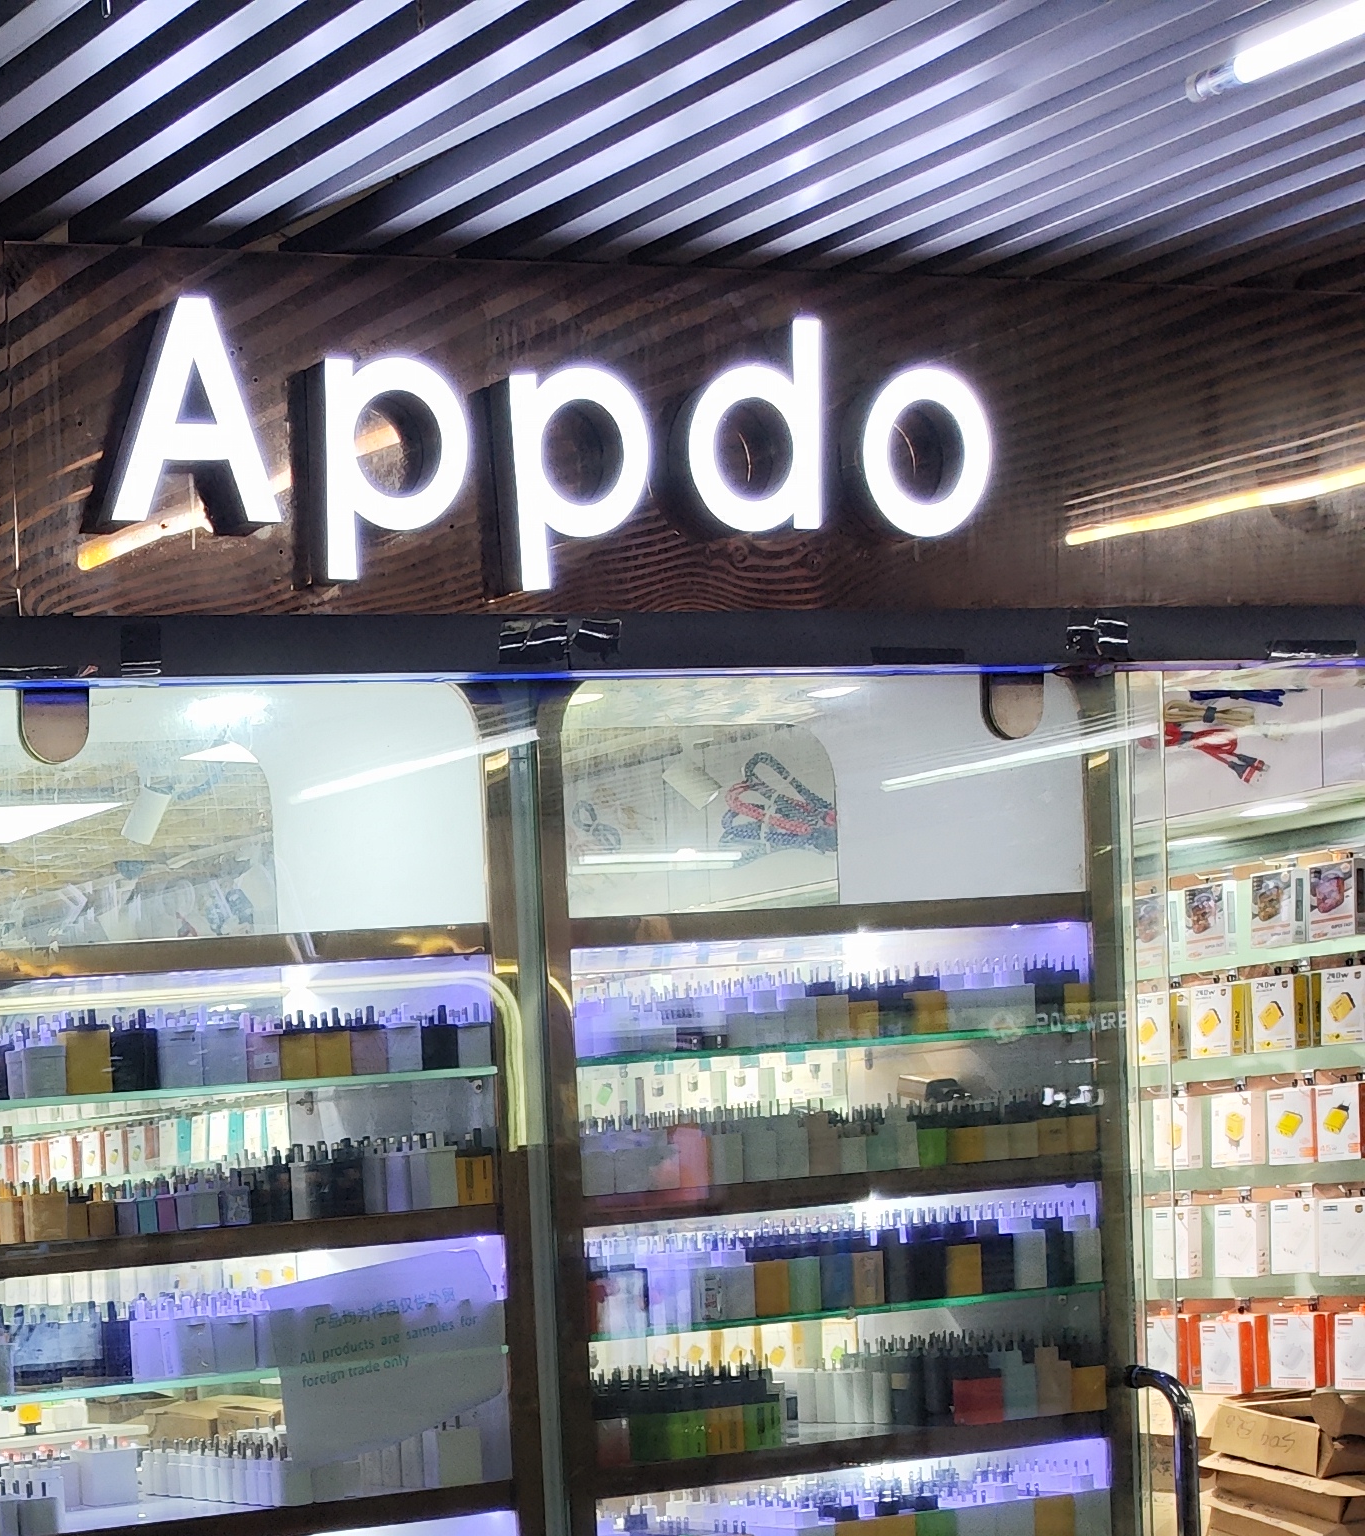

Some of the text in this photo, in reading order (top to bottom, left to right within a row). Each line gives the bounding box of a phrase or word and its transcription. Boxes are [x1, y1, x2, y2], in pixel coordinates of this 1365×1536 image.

[109, 293, 992, 592] Appdo
[299, 1314, 478, 1364] All products are samples for
[301, 1353, 410, 1388] foreign trade only
